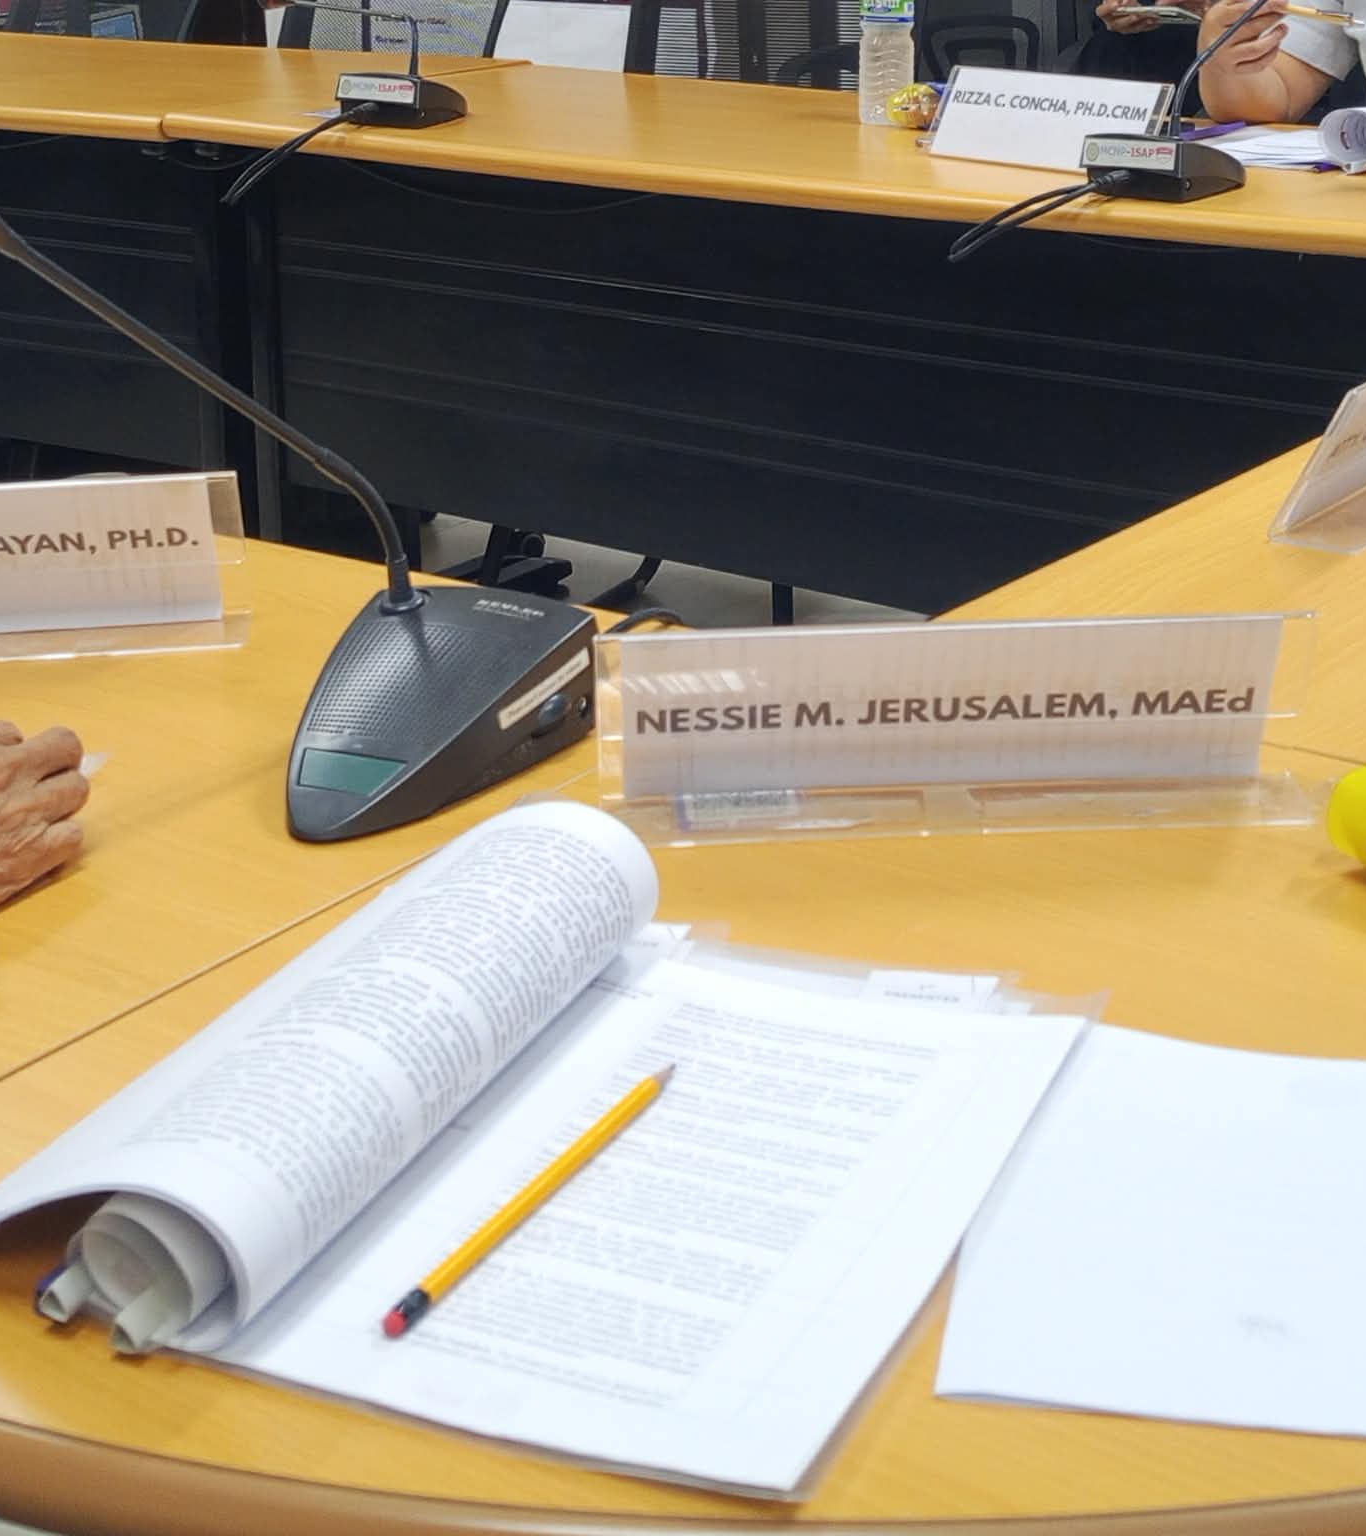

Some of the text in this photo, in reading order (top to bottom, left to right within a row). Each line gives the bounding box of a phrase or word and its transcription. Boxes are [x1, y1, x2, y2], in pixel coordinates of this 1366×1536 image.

[953, 90, 1148, 122] RIZZA C. CONCHA, PH.D.CRIM
[107, 528, 198, 549] PH.D.
[637, 688, 1254, 734] NESSIE M. JERUSALEM, MAEd
